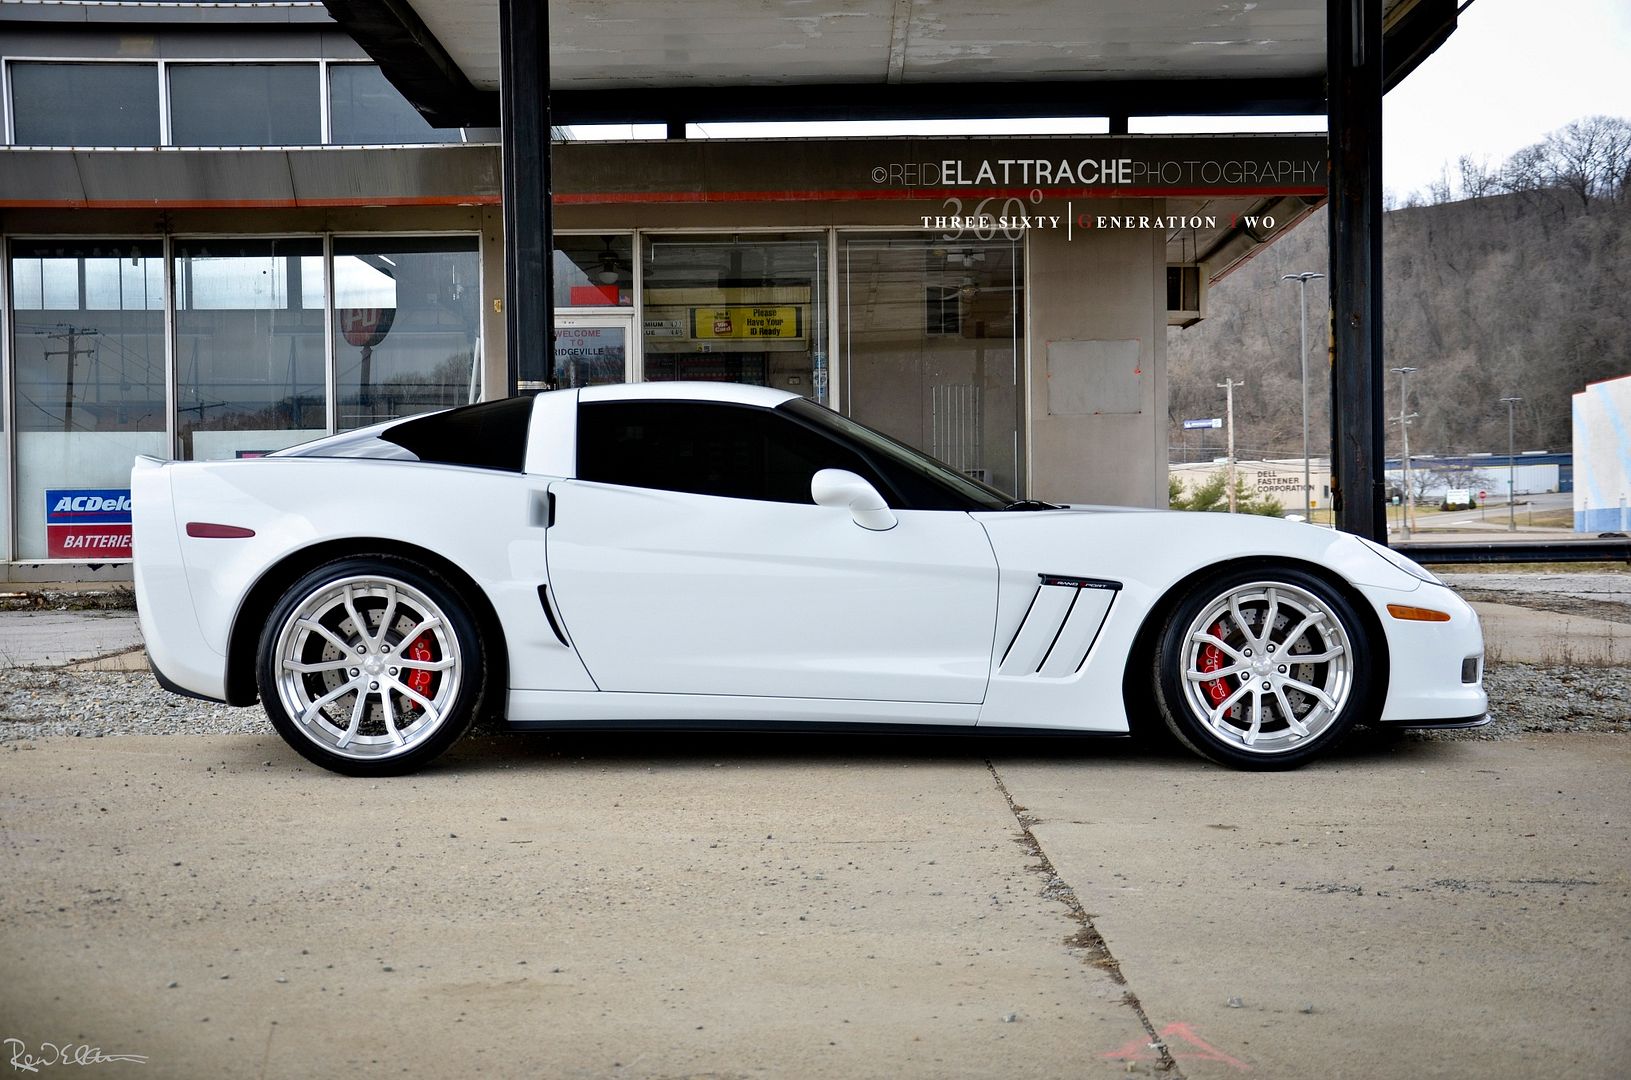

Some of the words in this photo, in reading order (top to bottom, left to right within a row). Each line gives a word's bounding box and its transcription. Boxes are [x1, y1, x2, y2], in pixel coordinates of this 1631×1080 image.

[753, 309, 777, 317] Please
[746, 318, 764, 326] Have
[766, 318, 784, 326] Your
[554, 329, 601, 337] WELCOME
[759, 327, 781, 336] Ready
[570, 339, 584, 347] TO
[554, 347, 605, 356] RIDGEVILLE
[1257, 470, 1277, 478] DELL
[1257, 477, 1299, 485] FASTENER
[1257, 484, 1315, 492] CORPORATIN
[53, 495, 132, 512] ACDelc
